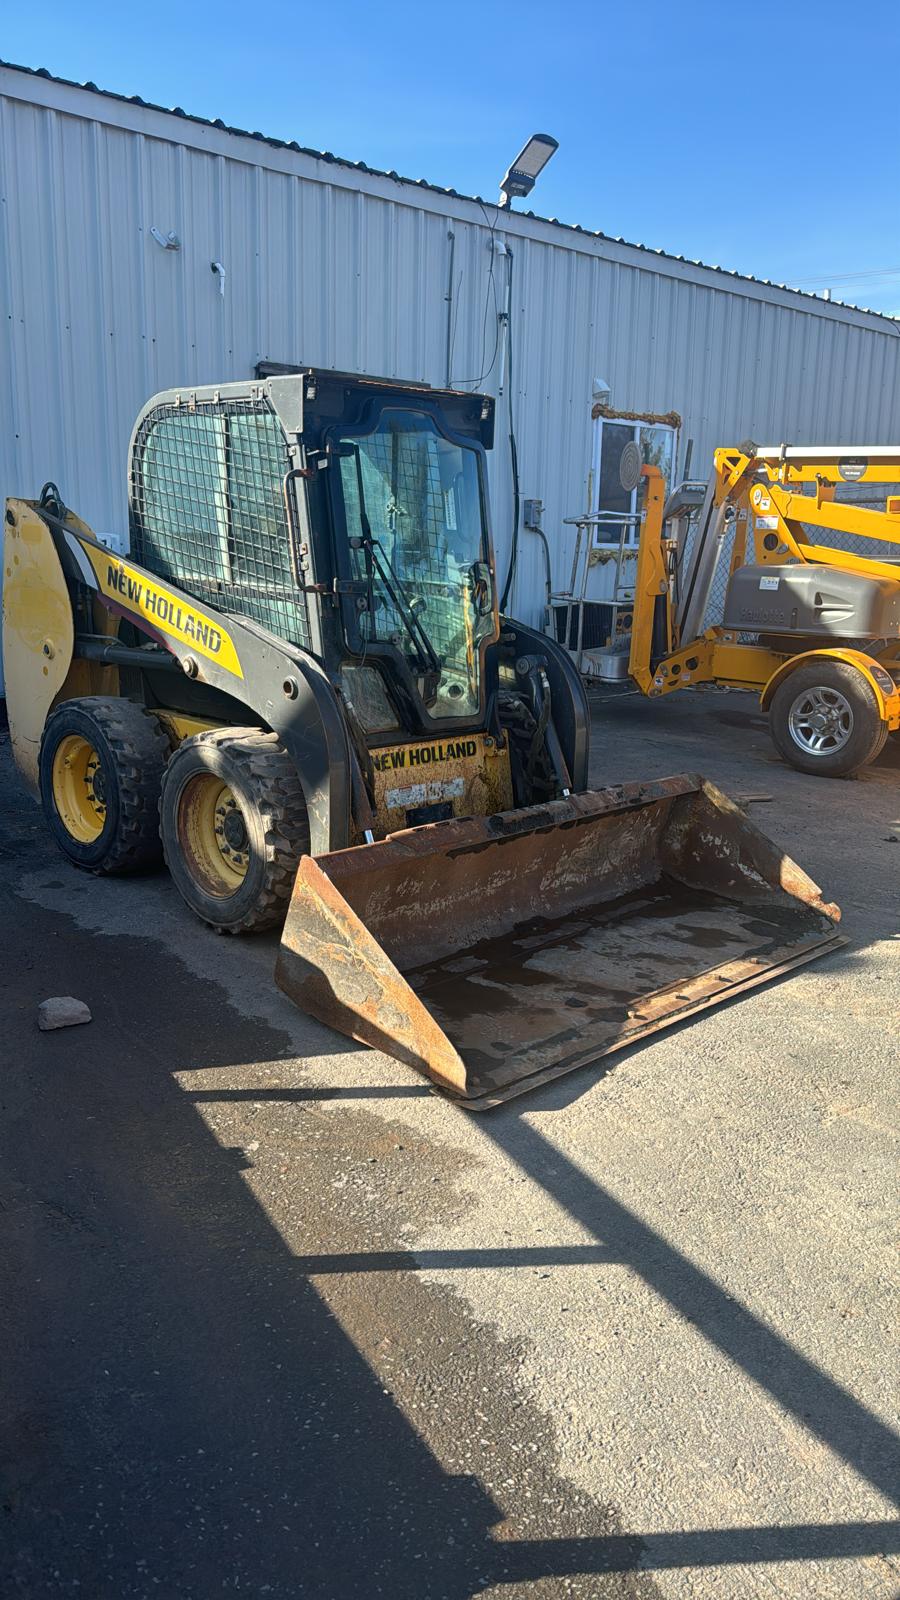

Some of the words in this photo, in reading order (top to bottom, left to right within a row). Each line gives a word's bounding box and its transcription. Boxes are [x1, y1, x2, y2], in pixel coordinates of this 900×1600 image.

[107, 567, 142, 604] NEW
[145, 591, 221, 653] HOLLAND
[371, 752, 405, 771] NEW
[409, 741, 477, 765] HOLLAND
